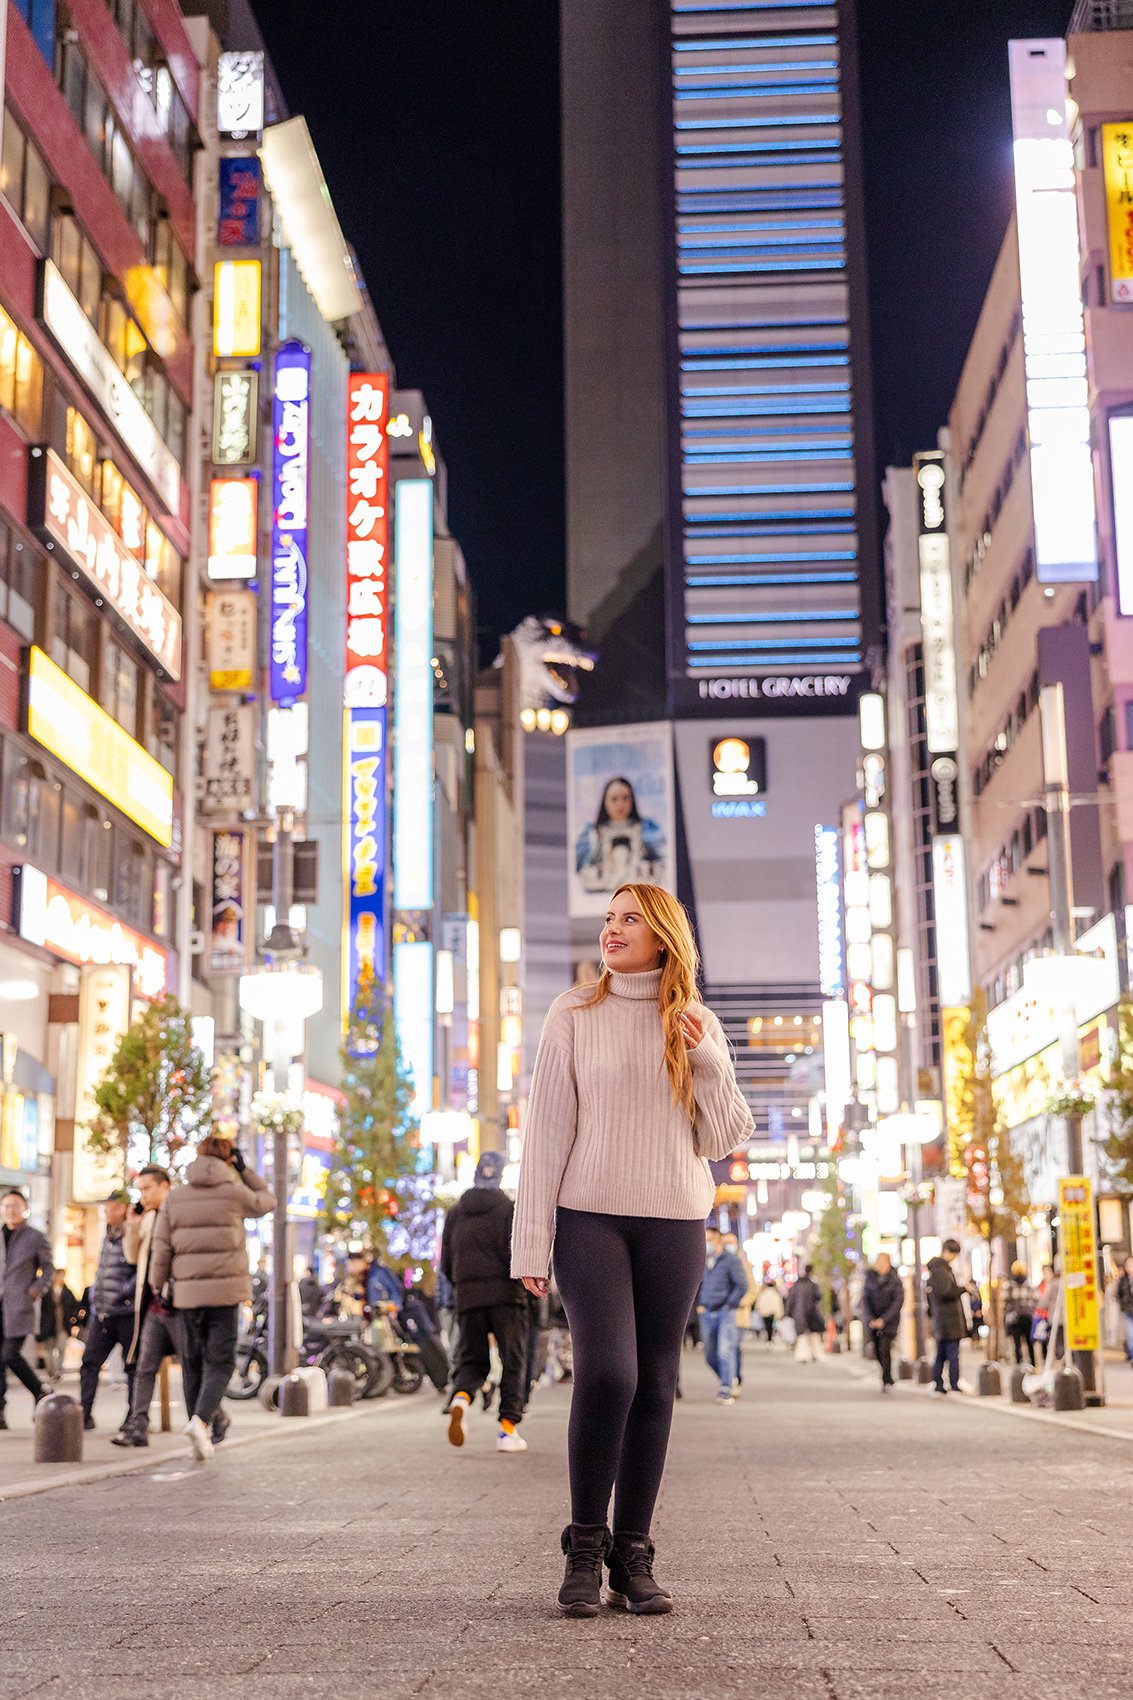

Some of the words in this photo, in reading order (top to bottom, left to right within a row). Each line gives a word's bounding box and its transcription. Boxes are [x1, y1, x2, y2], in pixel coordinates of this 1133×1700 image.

[349, 384, 385, 656] カラオケ歌広場
[699, 678, 762, 699] HOTEL
[762, 675, 851, 698] GRACERY
[711, 800, 767, 818] IMAX
